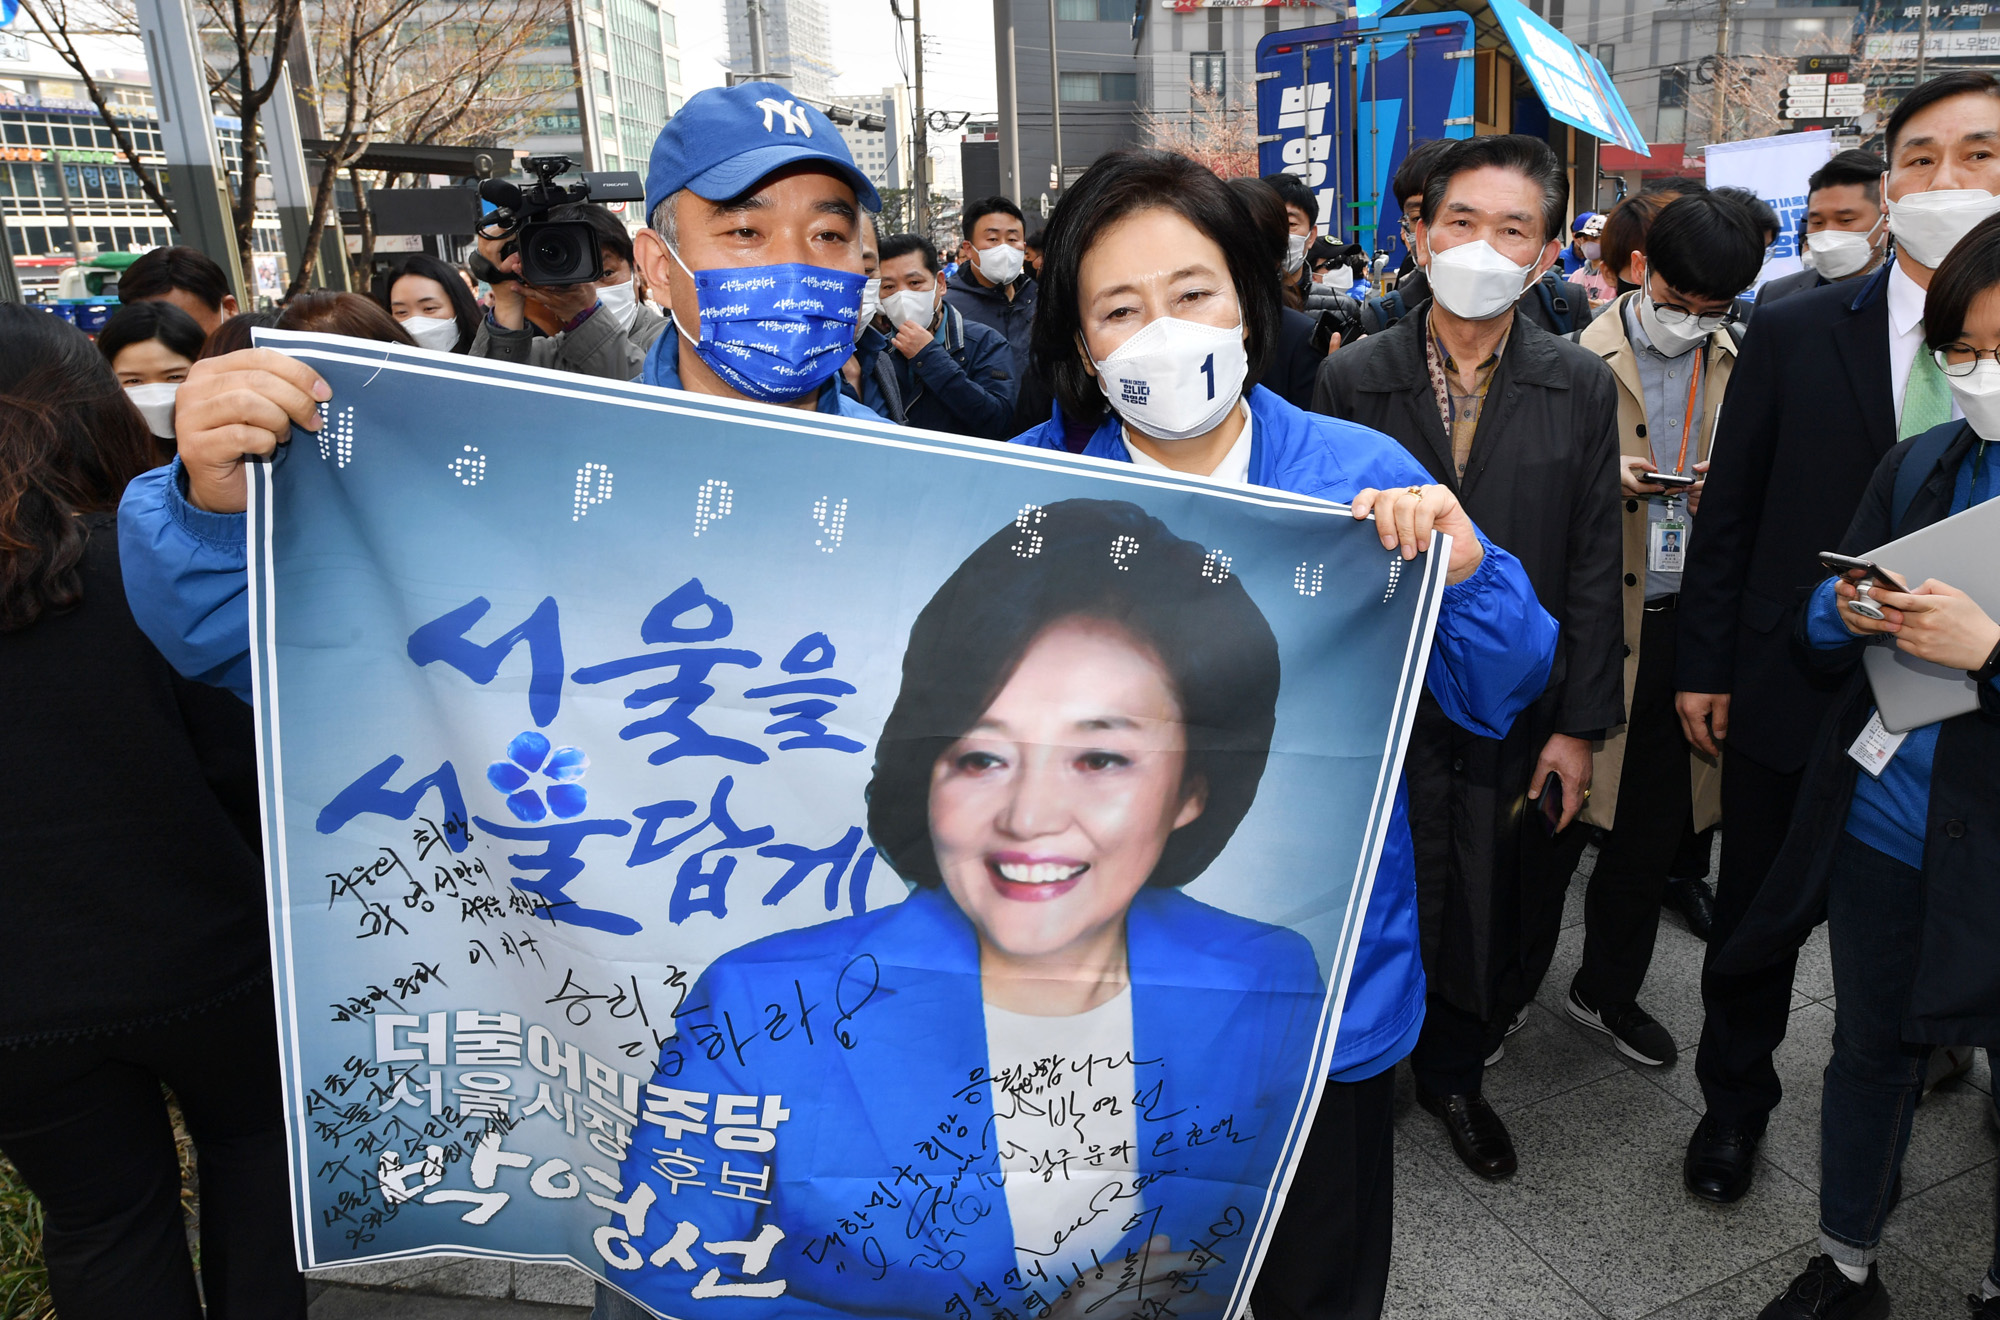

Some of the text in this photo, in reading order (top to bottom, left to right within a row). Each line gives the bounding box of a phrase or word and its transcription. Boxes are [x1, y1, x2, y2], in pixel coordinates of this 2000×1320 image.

[63, 165, 139, 188] 정형외과
[1121, 393, 1148, 406] 박영선
[1123, 384, 1151, 396] 합니다
[1200, 352, 1216, 402] 1
[374, 1010, 791, 1153] 더불어민주당
[376, 1070, 773, 1206] 서울시장 후보
[377, 1131, 787, 1299] 박영선
